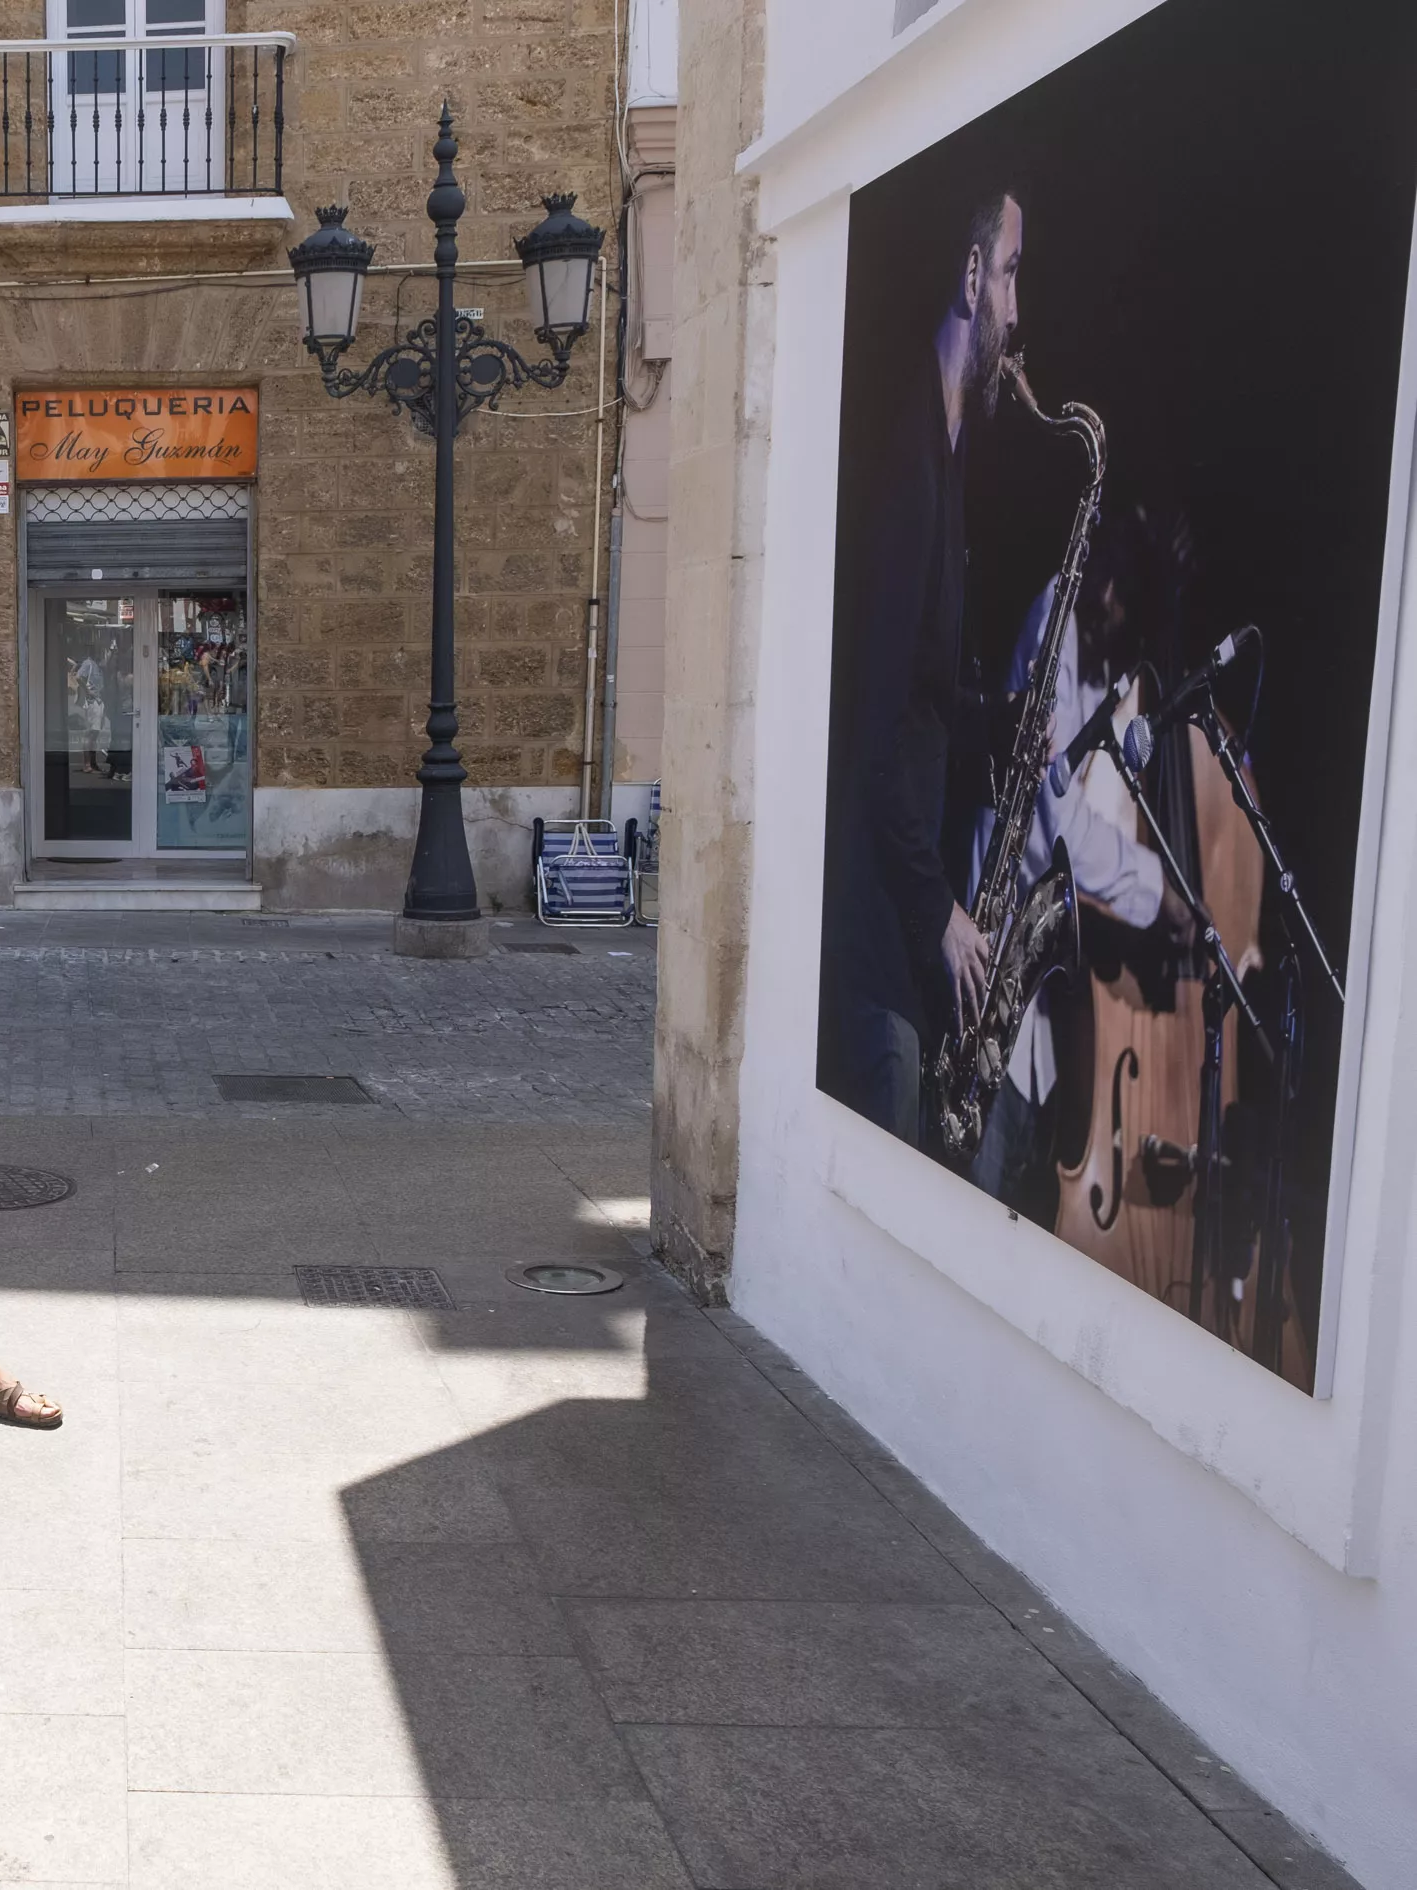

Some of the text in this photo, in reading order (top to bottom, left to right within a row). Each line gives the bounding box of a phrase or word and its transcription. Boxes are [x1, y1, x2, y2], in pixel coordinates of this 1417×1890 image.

[21, 396, 251, 420] PELUQUERIA
[29, 427, 243, 472] May Guzmán
